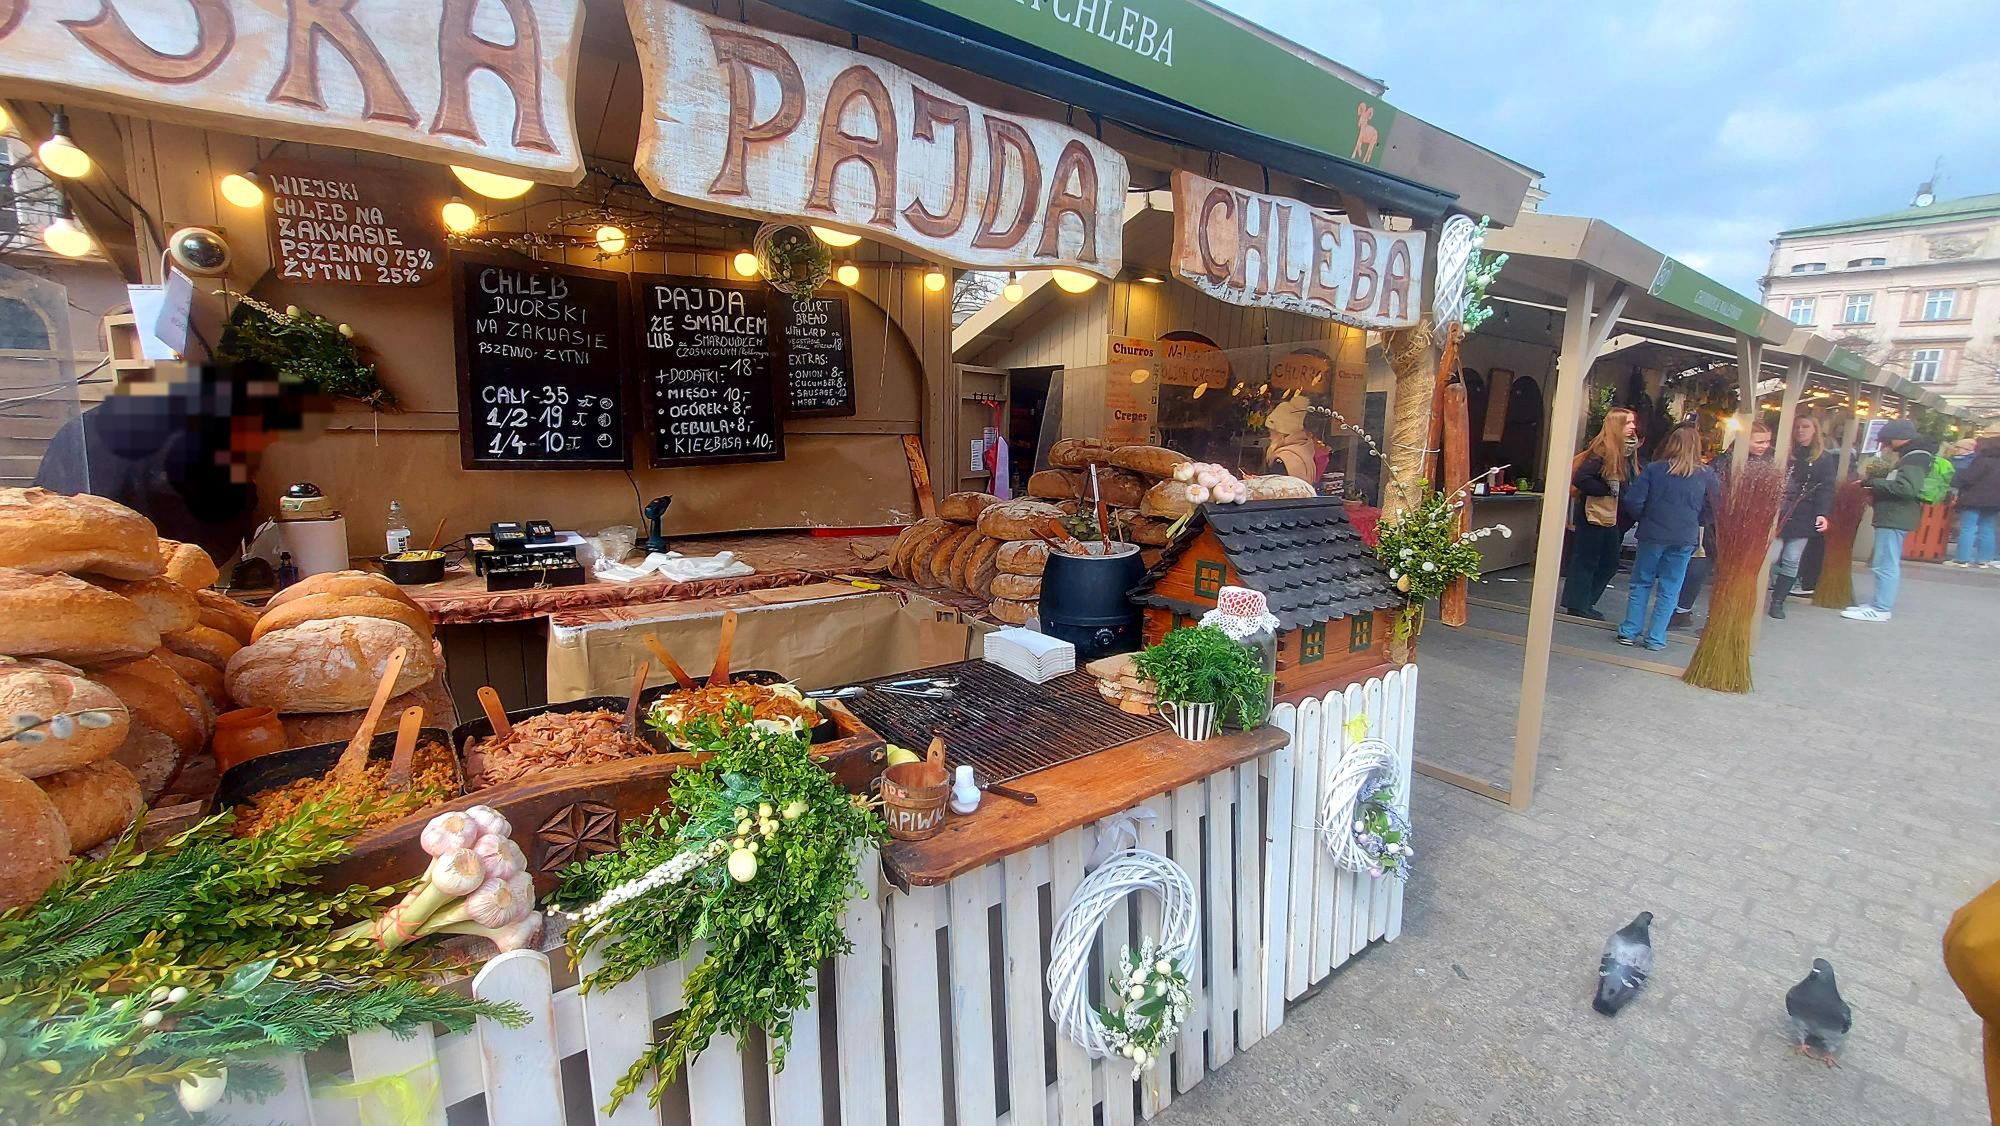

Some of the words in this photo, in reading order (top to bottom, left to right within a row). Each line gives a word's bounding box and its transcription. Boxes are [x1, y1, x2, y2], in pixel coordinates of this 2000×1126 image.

[1051, 0, 1174, 66] CHLEBA
[706, 25, 1098, 263] PAJDA
[270, 174, 359, 201] WIEJSKI
[273, 197, 348, 222] CHLEB
[356, 206, 384, 225] NA
[278, 218, 403, 246] ZAKWASIE
[280, 239, 389, 267] PSZENNO
[394, 248, 435, 271] 75%
[1199, 186, 1411, 319] CHLEBA
[284, 257, 362, 282] ŻYTNI
[377, 267, 421, 284] 25%
[480, 268, 568, 300] CHLEB
[488, 296, 586, 325] DWORSKI
[654, 286, 745, 316] PAJDA
[792, 300, 833, 313] COURT
[650, 315, 675, 332] ZE
[682, 314, 768, 335] SMALCEM
[796, 313, 828, 326] BREAD
[802, 327, 827, 338] LARD
[476, 319, 498, 334] NA
[506, 321, 608, 350] ZAKWASIE
[646, 332, 674, 349] LUB
[788, 352, 828, 366] EXTRAS:
[1113, 342, 1154, 357] Churros
[797, 388, 833, 398] SAUSAGE
[1114, 409, 1148, 423] Crepes
